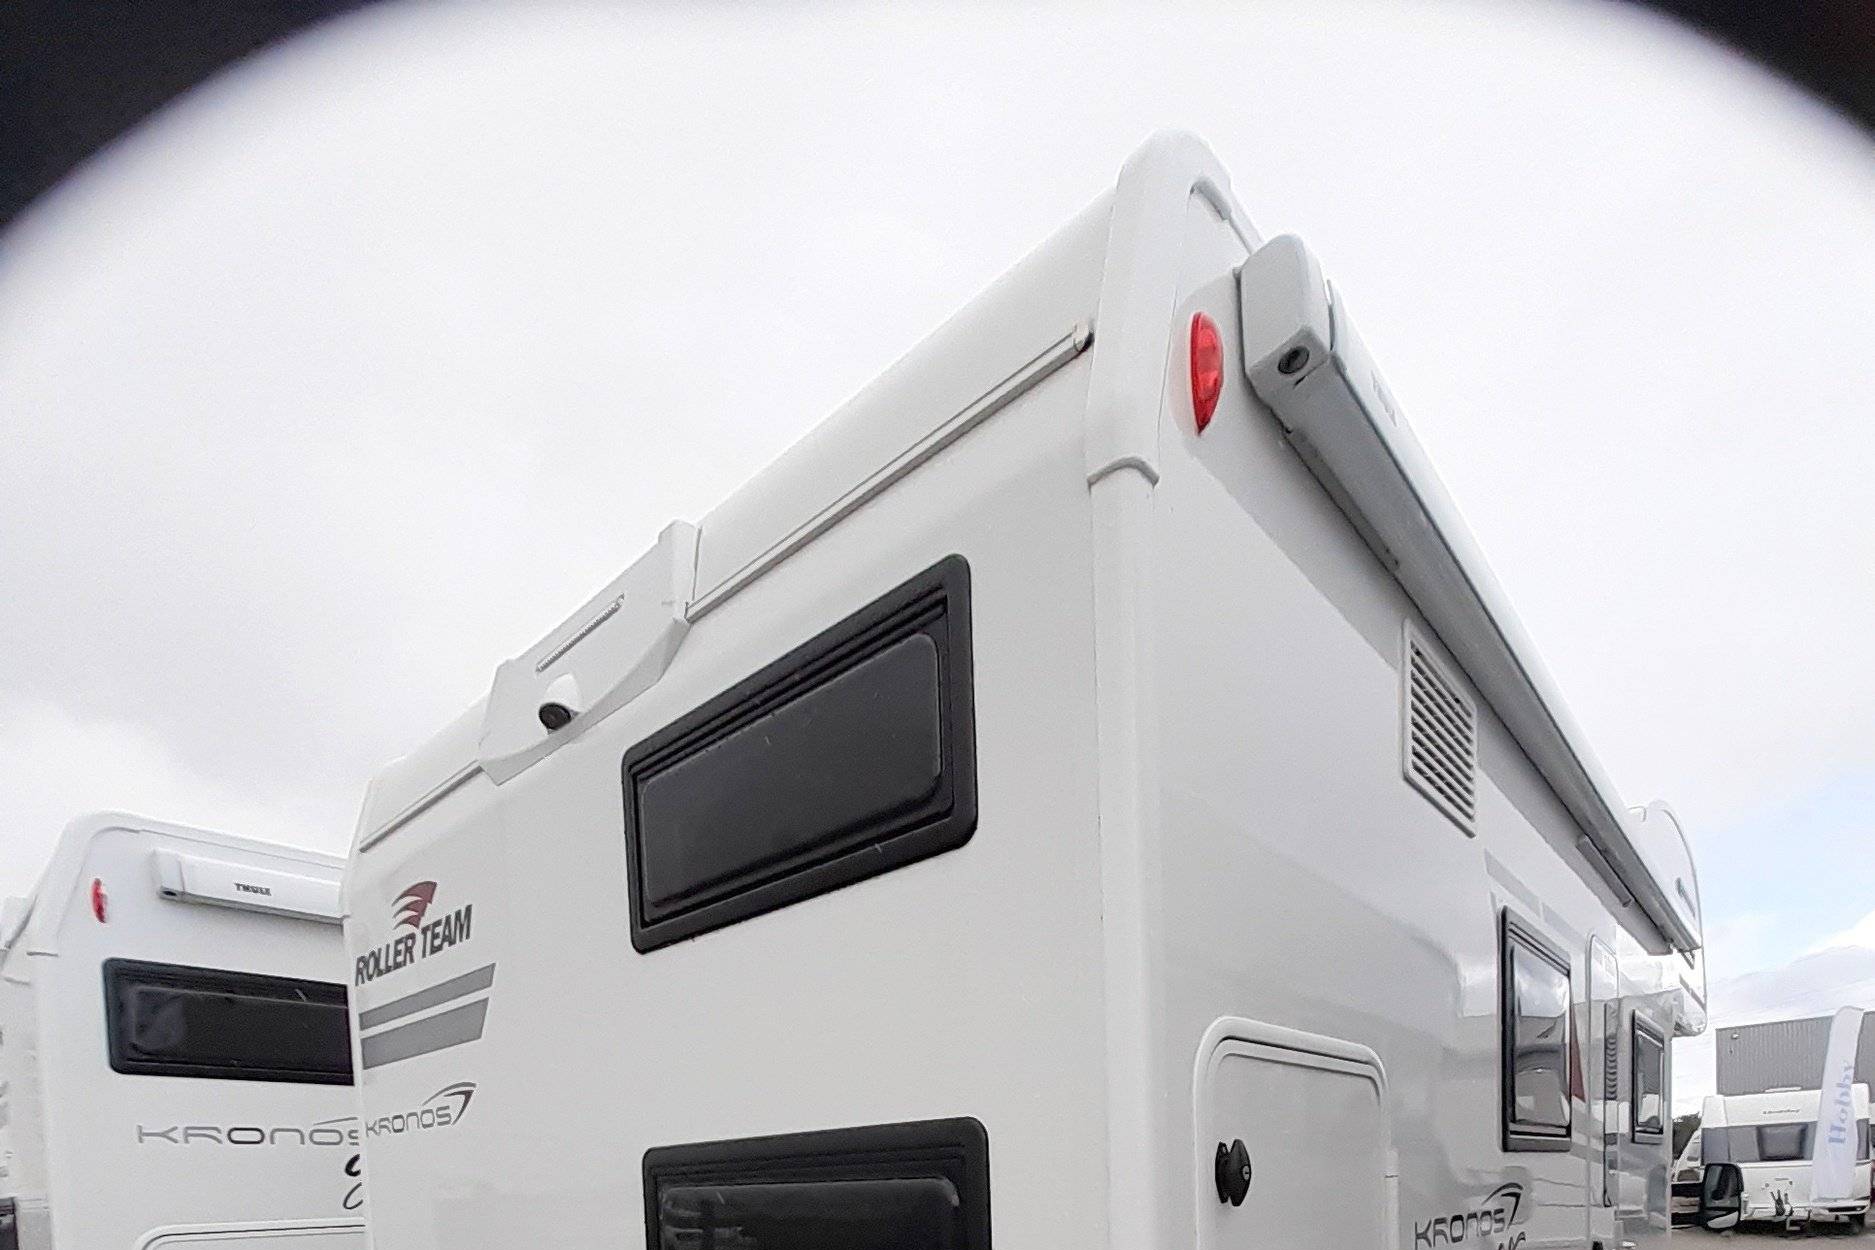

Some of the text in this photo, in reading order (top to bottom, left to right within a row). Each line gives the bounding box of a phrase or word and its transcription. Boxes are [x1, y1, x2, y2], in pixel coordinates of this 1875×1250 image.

[355, 903, 473, 987] ROLLER TEAM
[364, 1105, 453, 1138] KRONOS
